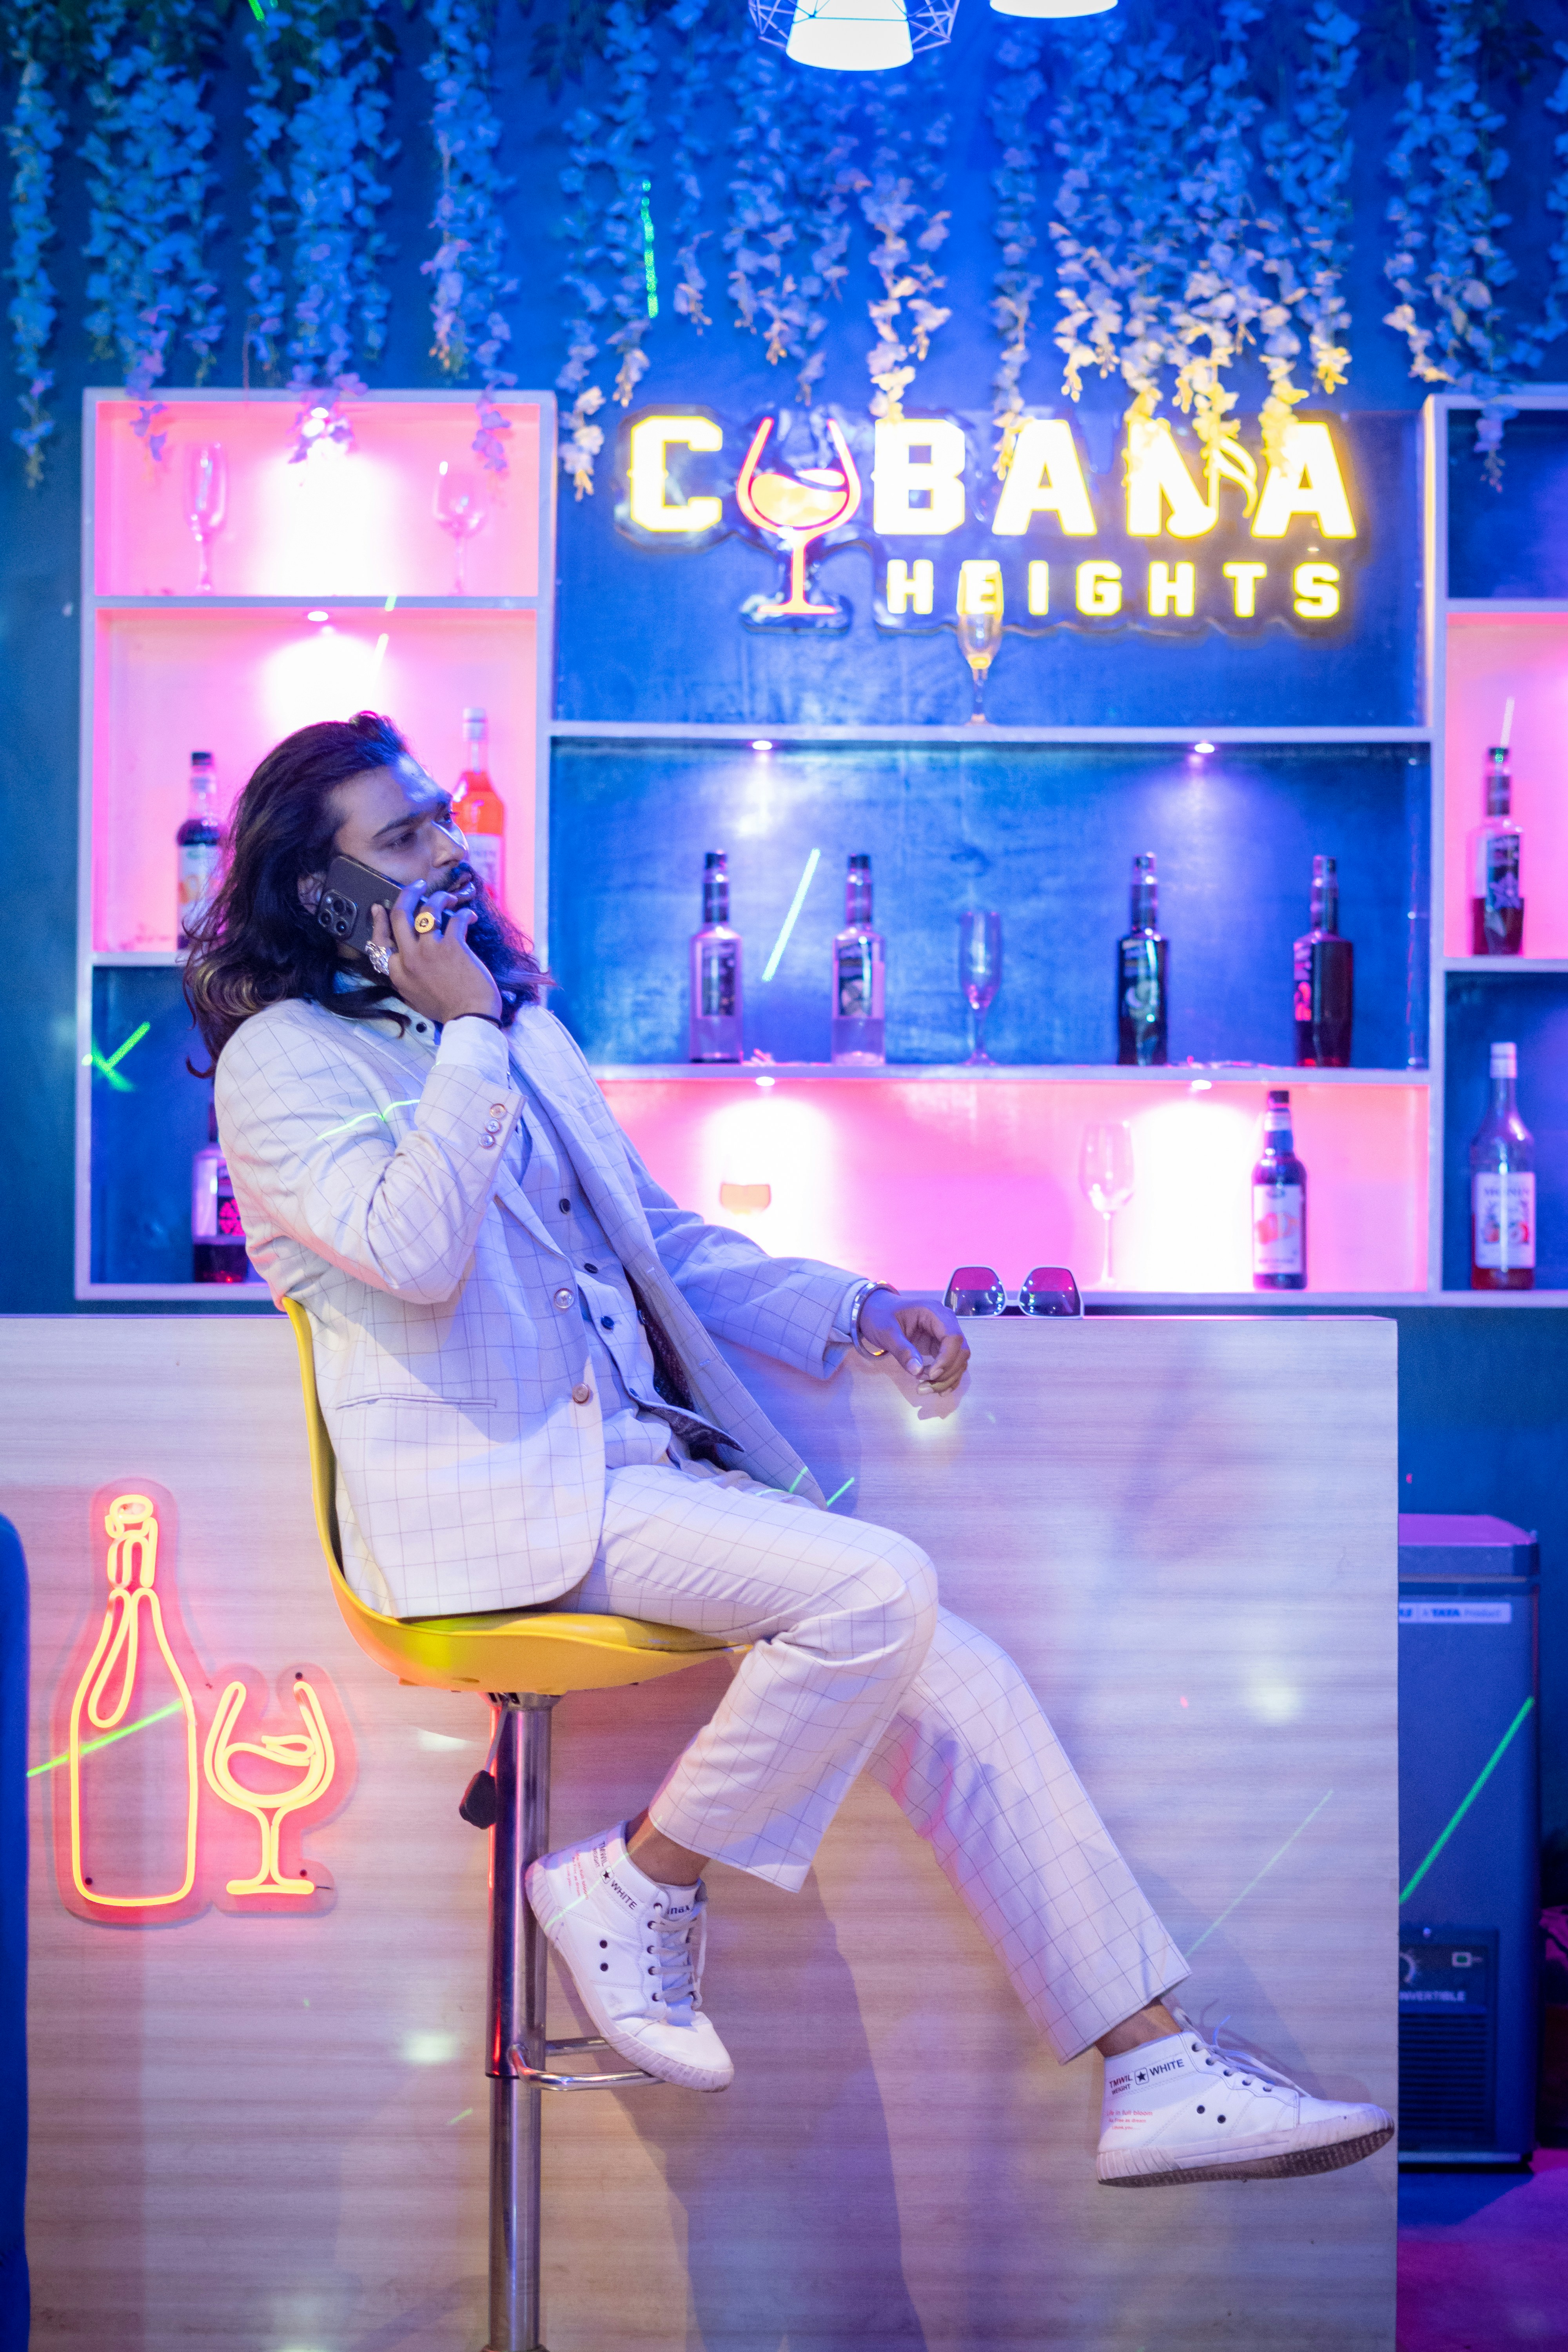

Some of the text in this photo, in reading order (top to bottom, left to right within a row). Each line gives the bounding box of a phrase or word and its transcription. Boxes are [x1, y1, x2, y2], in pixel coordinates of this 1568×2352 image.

[886, 557, 1341, 619] HEIGHTS
[611, 1880, 637, 1910] WHITE
[1149, 2059, 1185, 2076] WHITE
